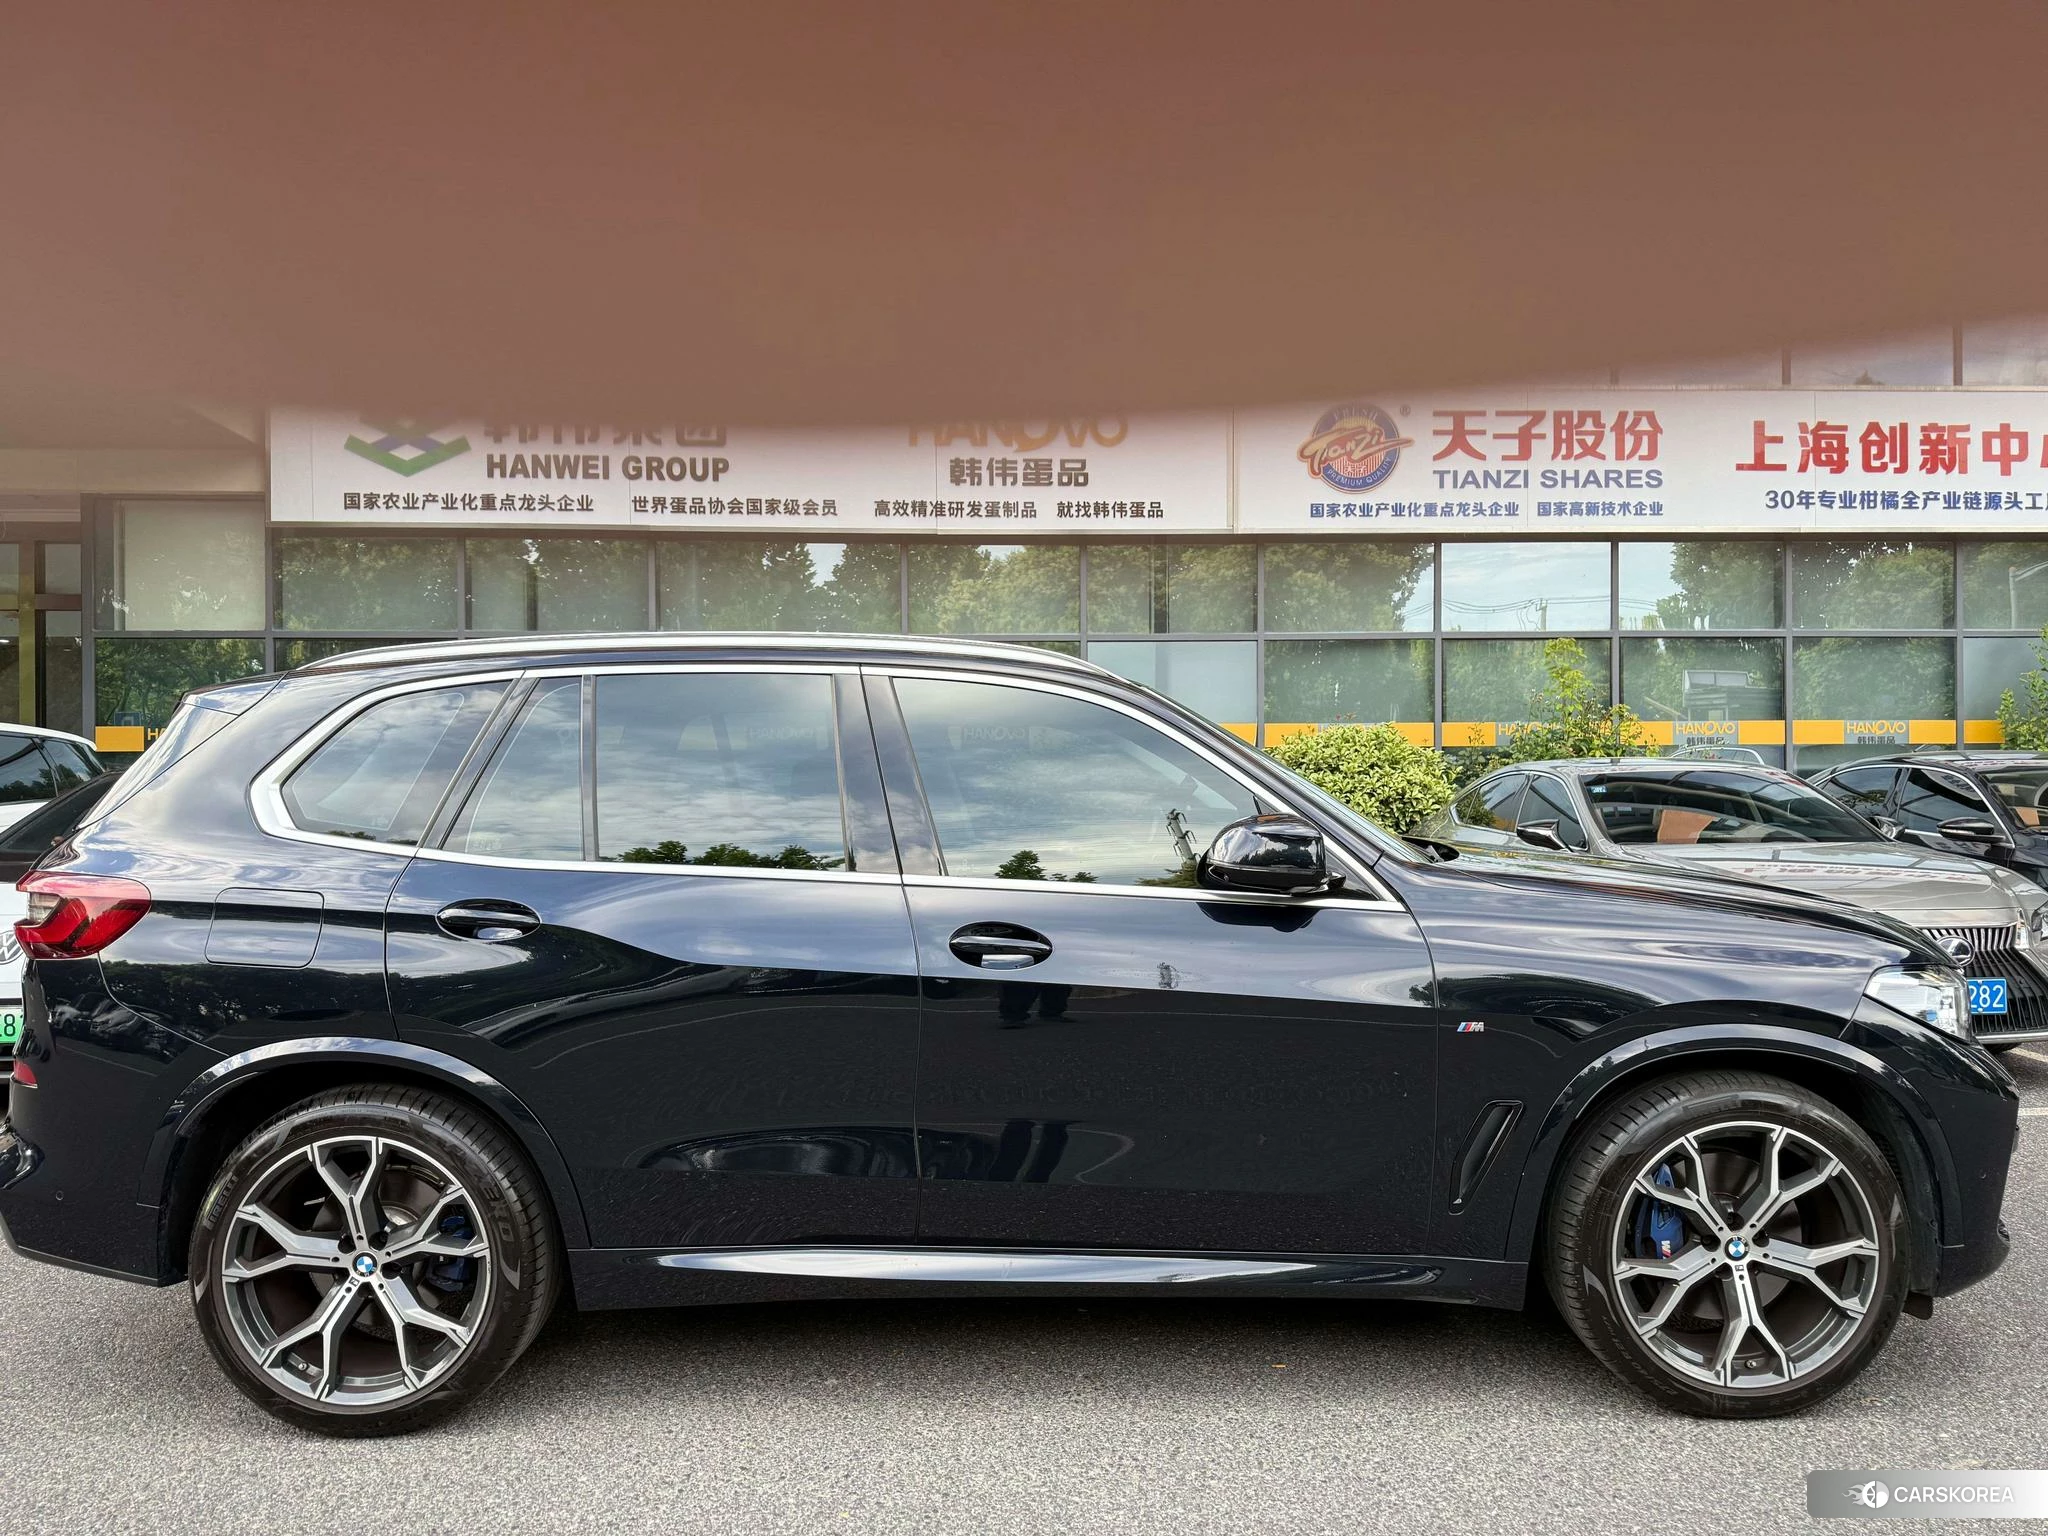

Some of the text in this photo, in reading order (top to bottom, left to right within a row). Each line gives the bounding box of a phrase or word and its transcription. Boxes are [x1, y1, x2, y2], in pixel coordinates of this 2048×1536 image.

[1432, 410, 1664, 462] 天子股份
[1736, 420, 2048, 477] 上海创新中
[486, 454, 730, 482] HANWEI GROUP
[949, 457, 1089, 487] 韩伟蛋品
[1327, 457, 1392, 487] PREMIUM QUALITY
[1433, 469, 1664, 489] TIANZI SHARES
[343, 491, 595, 513] 国家农业产业化重点龙头企业
[631, 496, 838, 517] 世界蛋品协会国家级会员
[873, 500, 1164, 519] 高效精准研发蛋制品 就找韩伟蛋品
[1309, 501, 1664, 518] 国家农业产业化重点龙头企业 国家高新技术企业
[1764, 489, 2048, 512] 30年专业柑橘全产业链源头工
[1675, 720, 1736, 735] HANOVO
[1846, 720, 1906, 735] HANOVO
